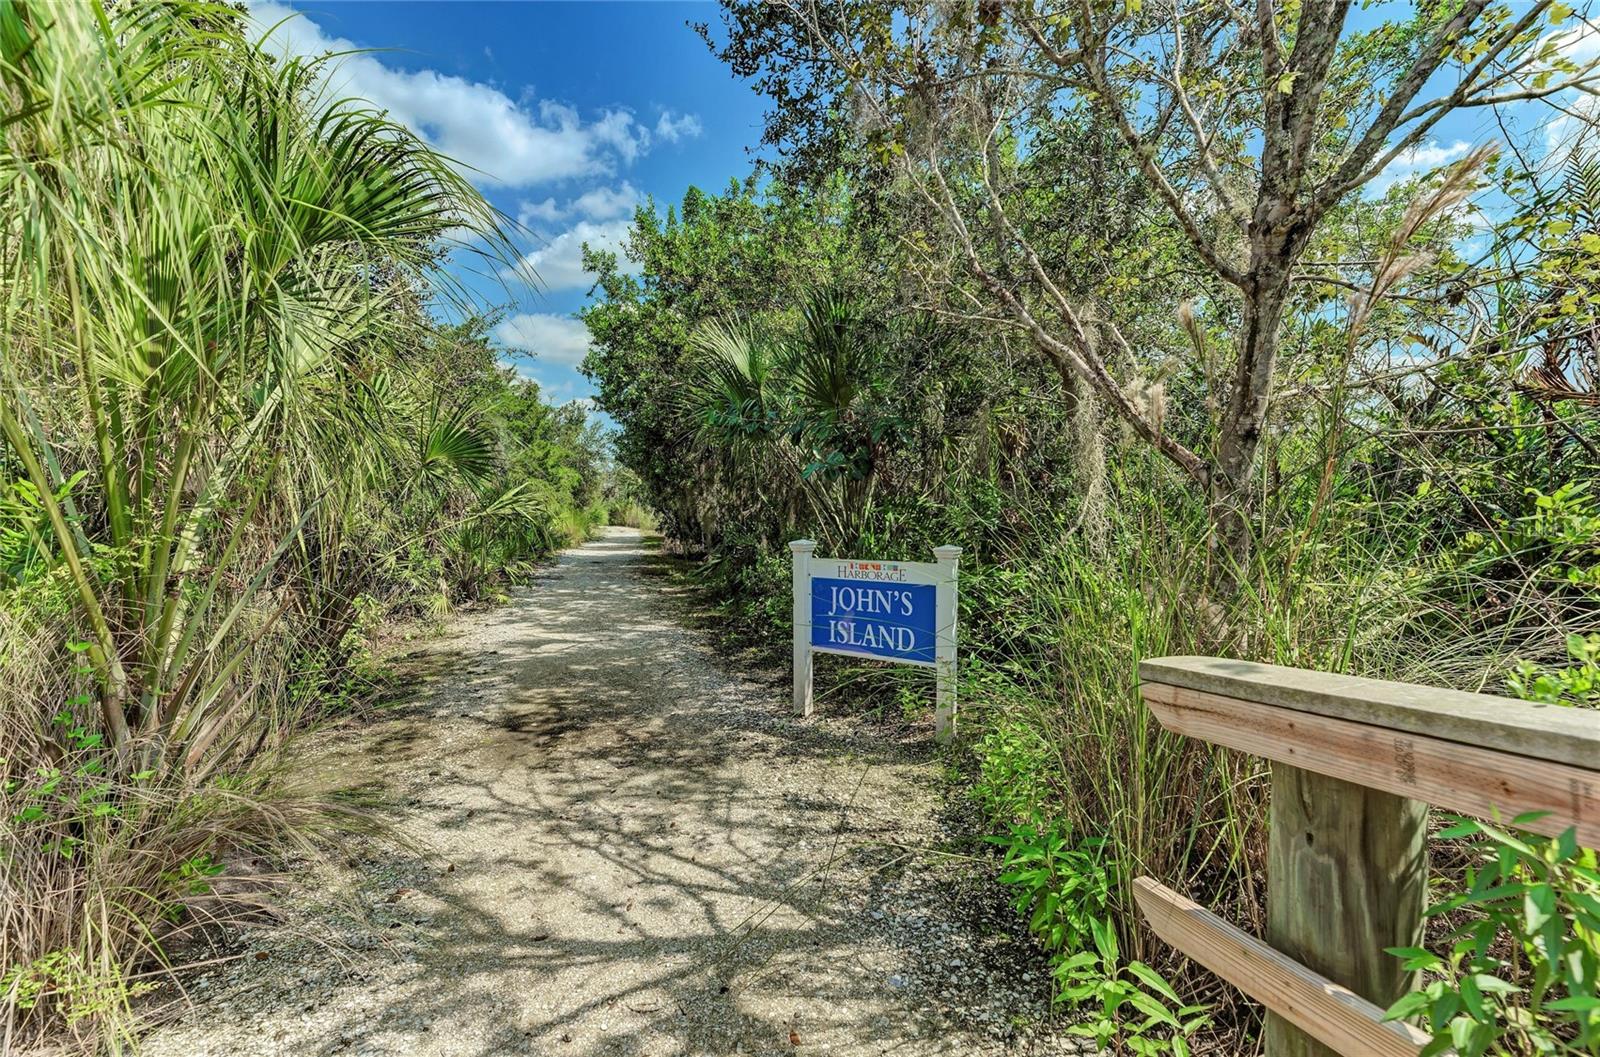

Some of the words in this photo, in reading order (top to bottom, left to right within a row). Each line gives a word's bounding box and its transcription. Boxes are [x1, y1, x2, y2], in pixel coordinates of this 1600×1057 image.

[838, 565, 907, 582] HARBORAGE
[828, 586, 913, 616] JOHN'S
[829, 620, 915, 652] ISLAND
